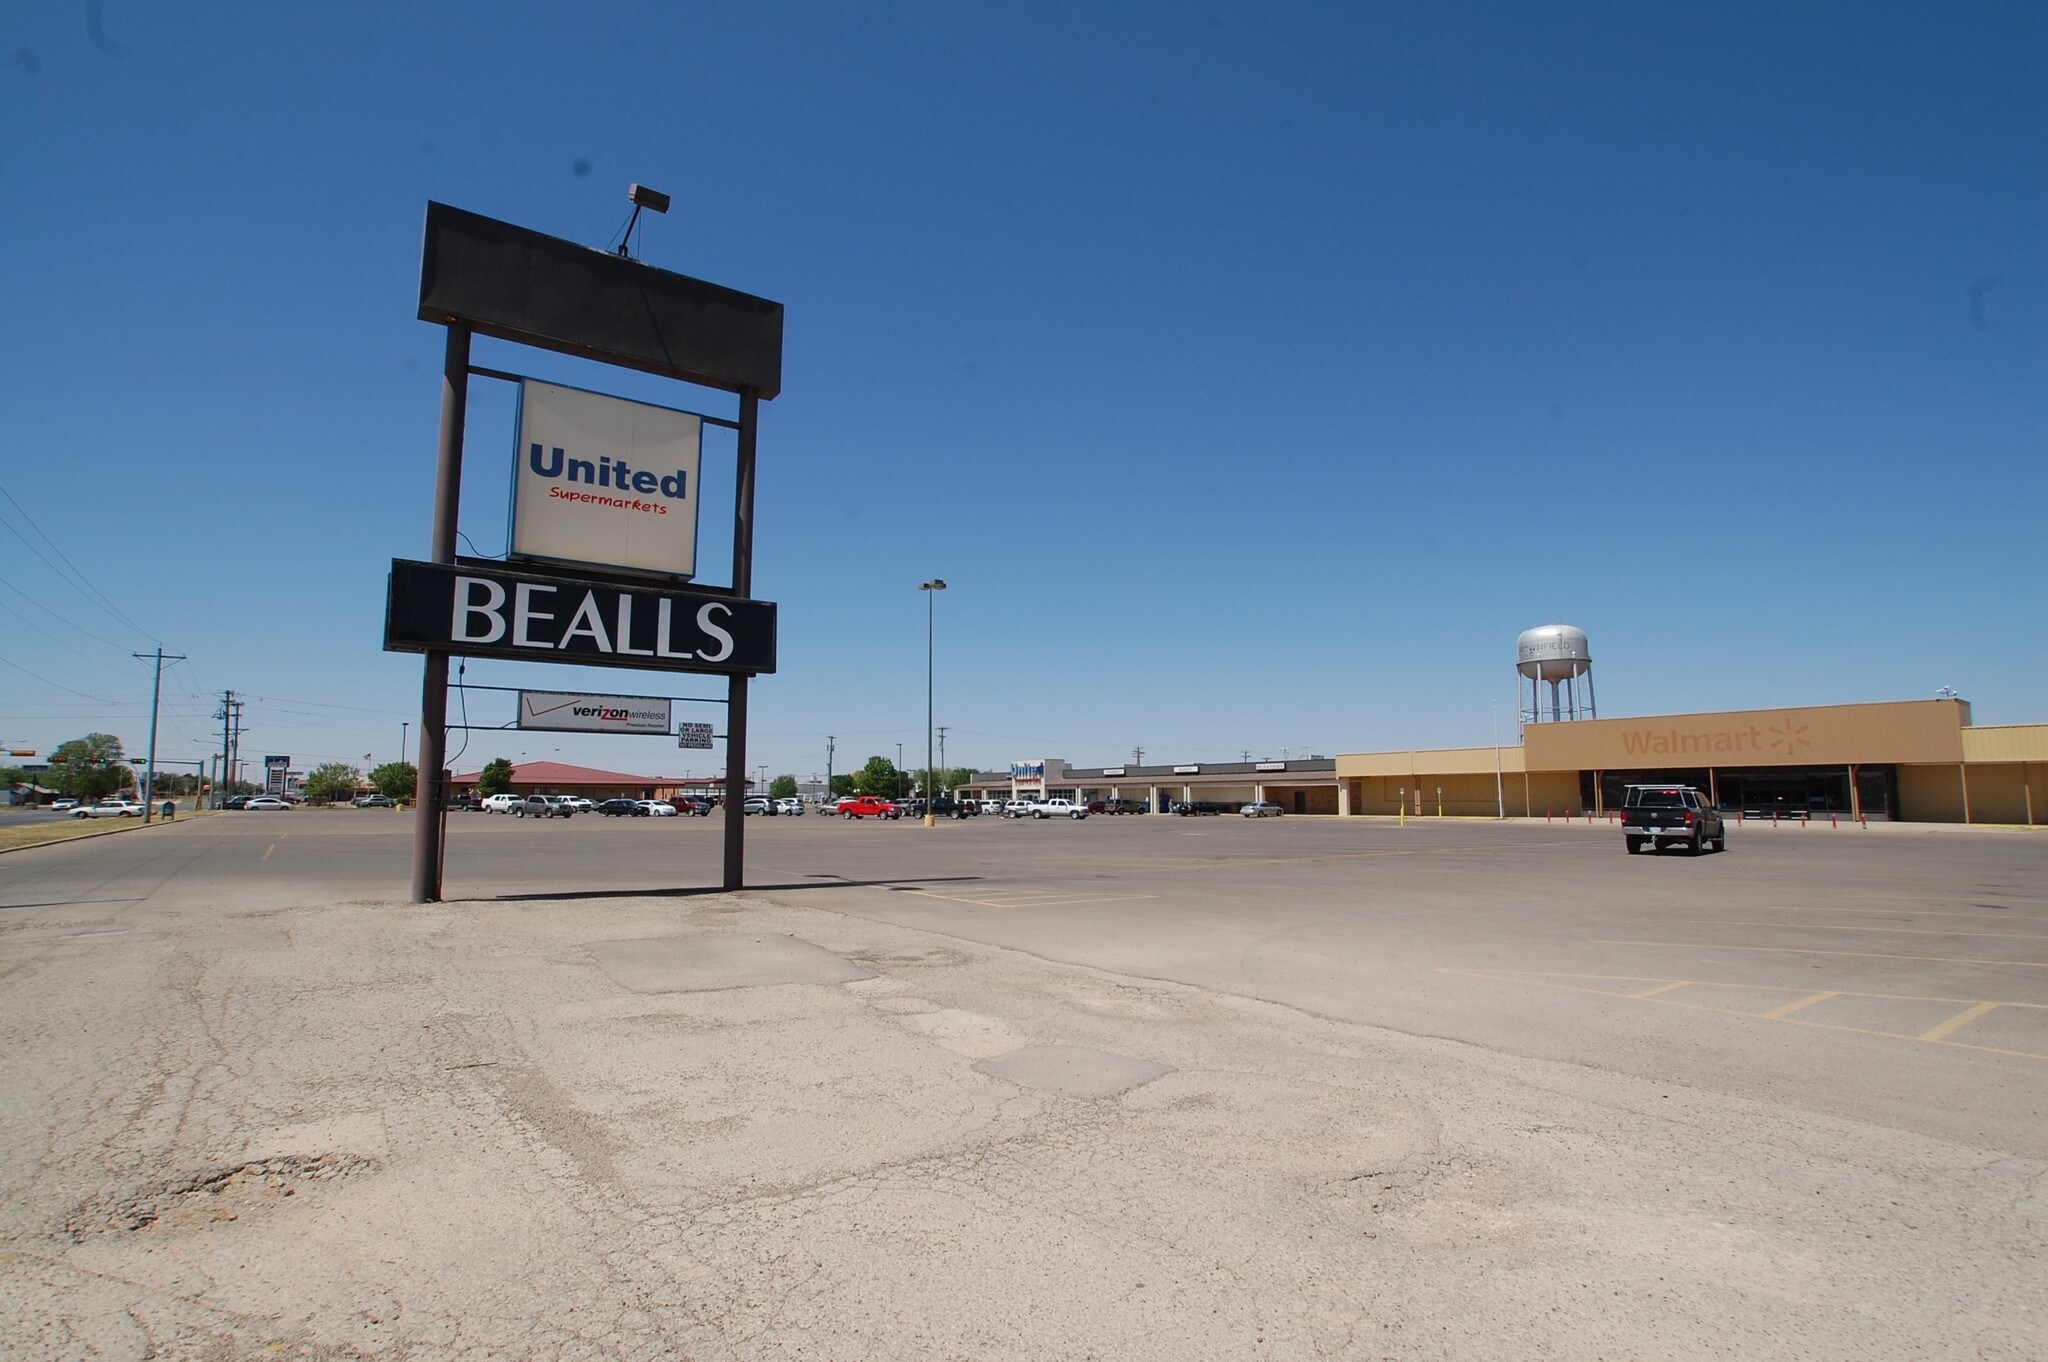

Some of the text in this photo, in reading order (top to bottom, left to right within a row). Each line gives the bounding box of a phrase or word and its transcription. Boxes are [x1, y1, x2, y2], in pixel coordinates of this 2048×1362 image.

[530, 443, 687, 499] United
[549, 486, 667, 514] Supermarkets
[451, 576, 734, 662] BEALLS
[1620, 726, 1762, 755] Walmart
[1010, 762, 1044, 777] United
